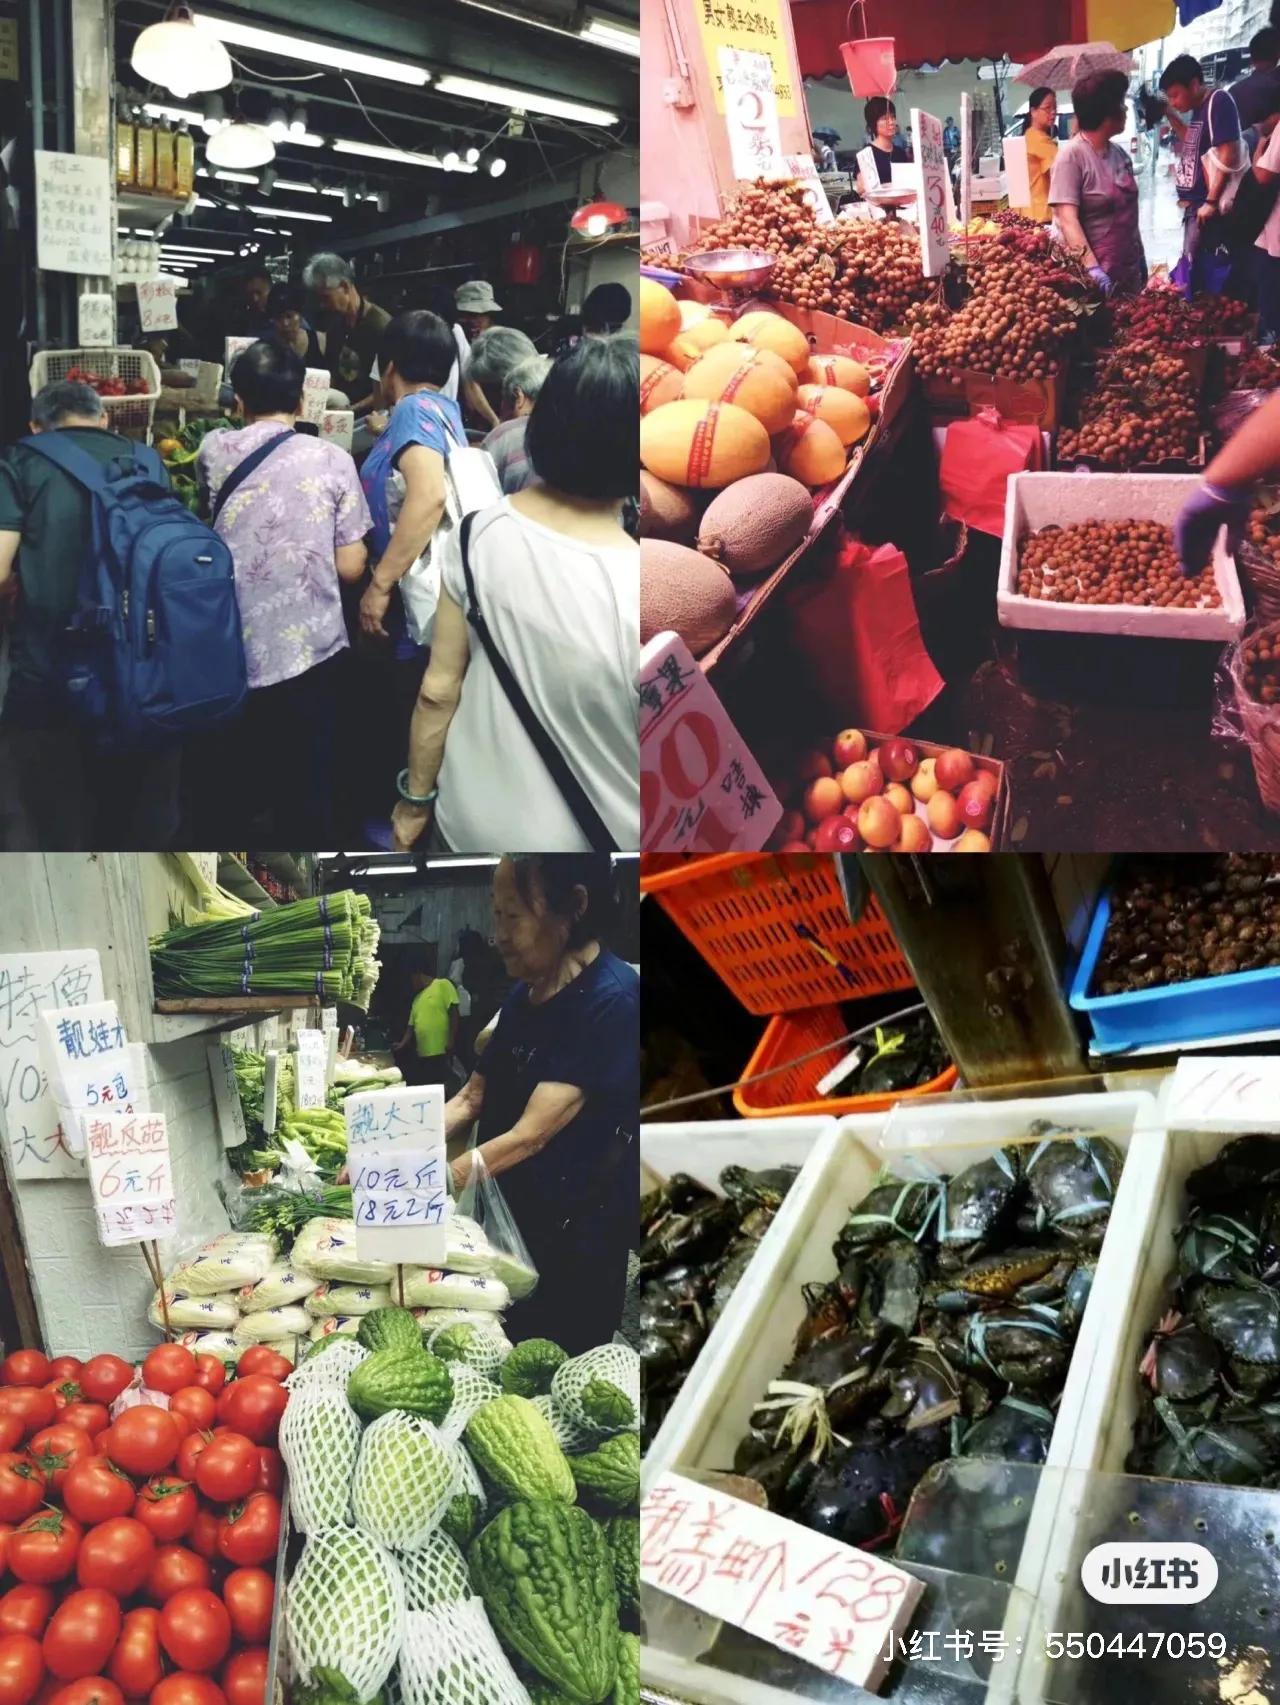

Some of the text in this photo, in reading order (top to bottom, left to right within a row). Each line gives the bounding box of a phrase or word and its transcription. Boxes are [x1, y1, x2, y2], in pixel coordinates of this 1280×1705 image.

[100, 1160, 165, 1198] 6元斤
[352, 1159, 437, 1193] 10元斤
[356, 1191, 444, 1224] 18元2斤
[797, 1551, 906, 1623] 128
